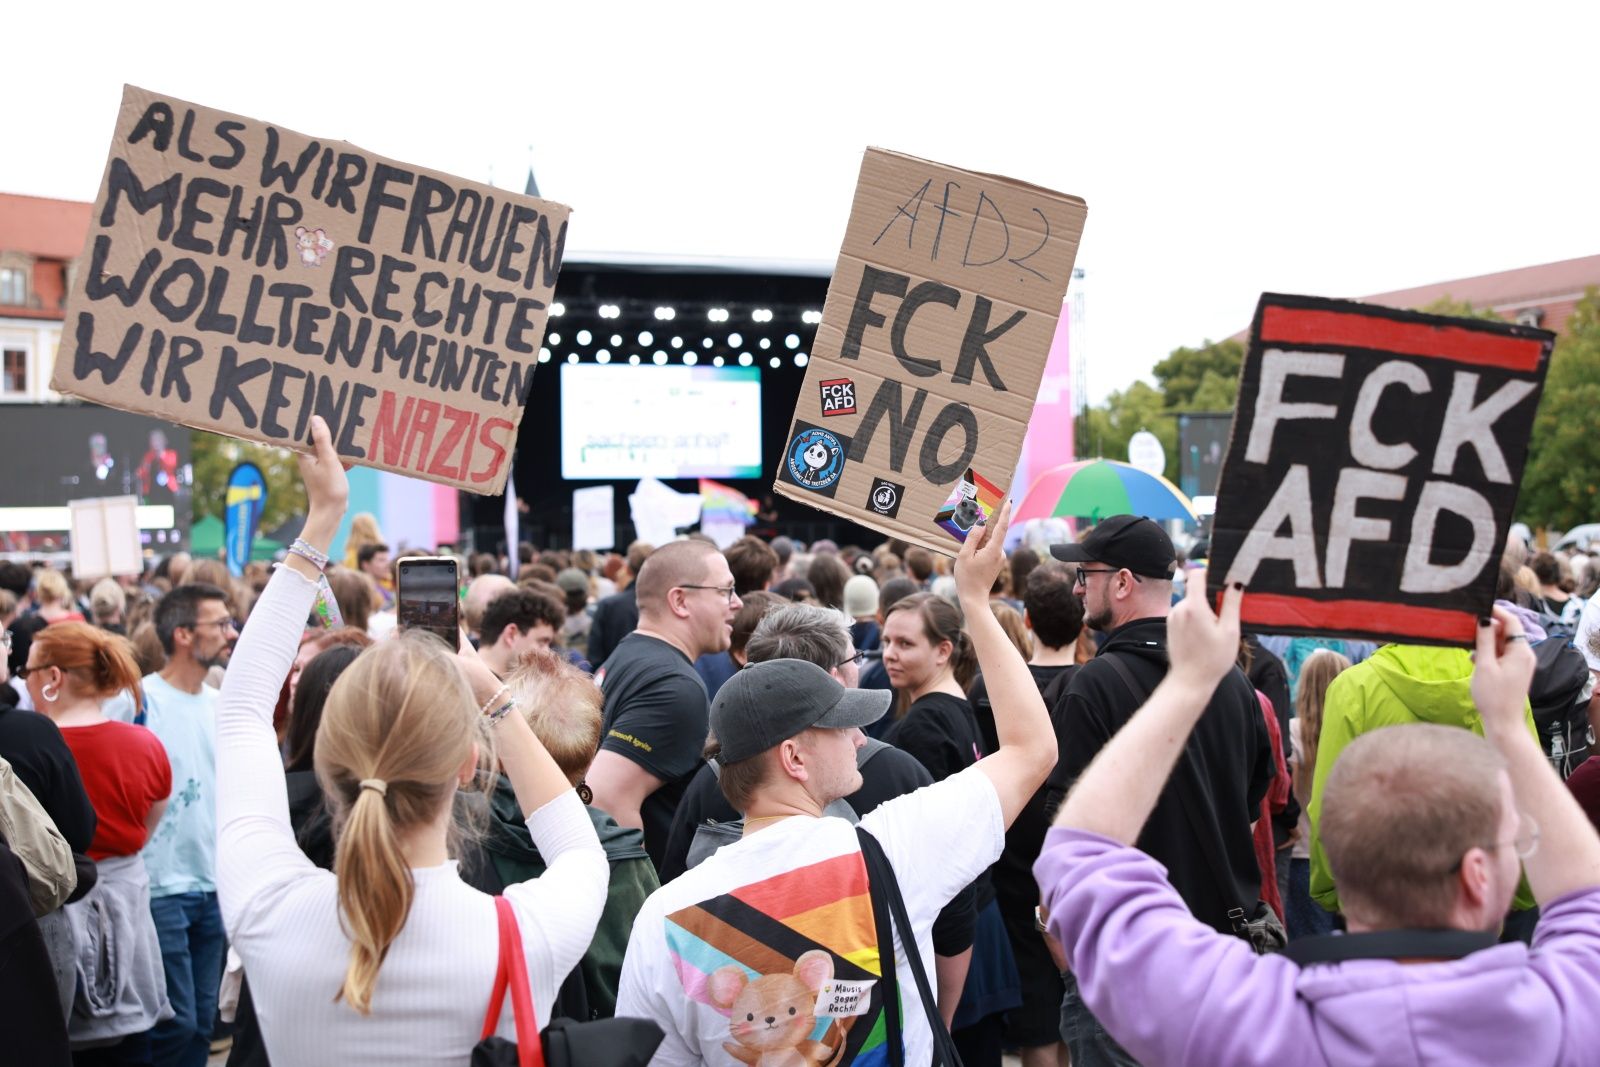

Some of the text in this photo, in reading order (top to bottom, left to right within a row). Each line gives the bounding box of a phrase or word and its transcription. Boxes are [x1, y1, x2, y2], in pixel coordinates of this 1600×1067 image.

[100, 157, 546, 354] MEHR RECHTE
[127, 101, 568, 290] ALS WIR FRAUEN
[84, 234, 537, 407] WOLLTEN MEINTEN
[840, 264, 1028, 392] FCK
[73, 312, 515, 484] WIR KEINE NAZIS
[821, 383, 854, 399] FCK
[823, 396, 855, 411] AFD
[845, 377, 979, 485] NO
[1245, 349, 1538, 484] FCK
[1224, 464, 1496, 594] AFD
[834, 984, 861, 993] Mausis
